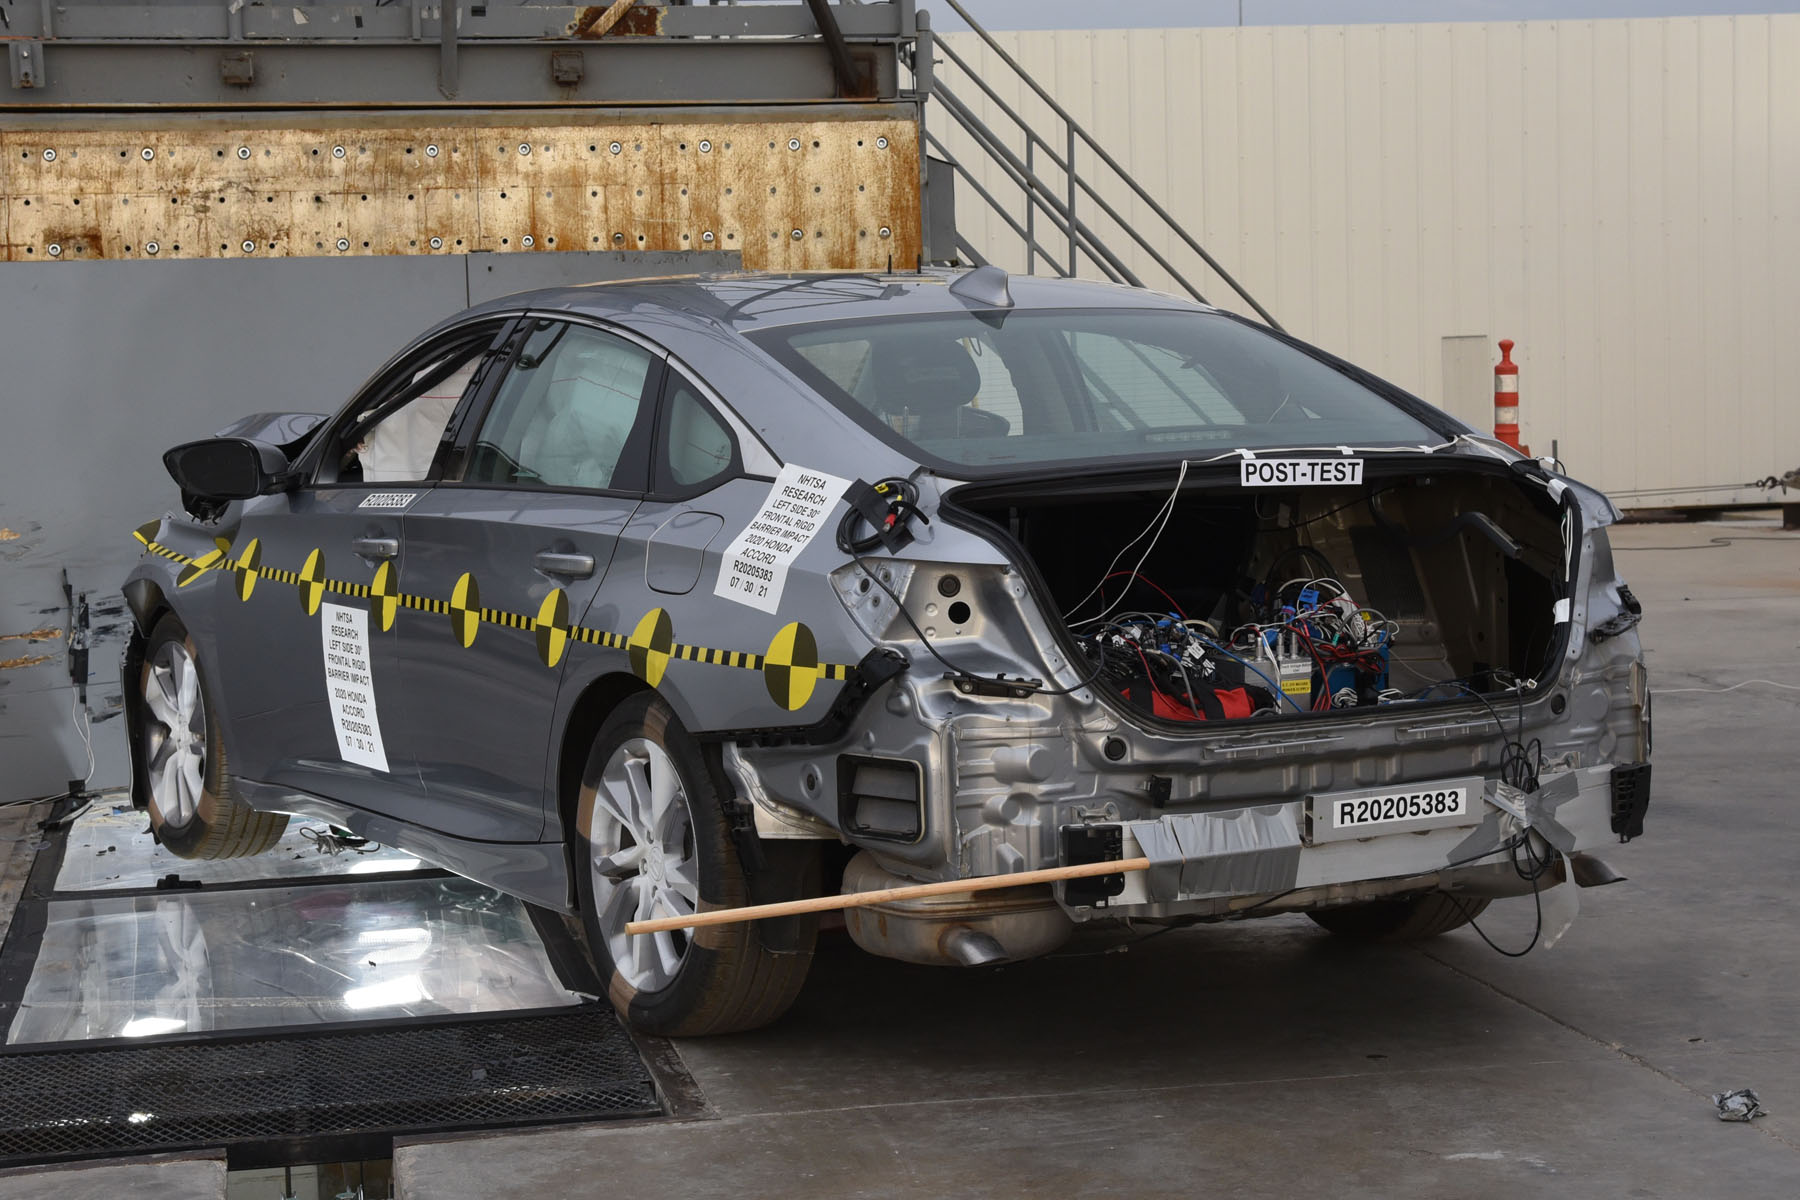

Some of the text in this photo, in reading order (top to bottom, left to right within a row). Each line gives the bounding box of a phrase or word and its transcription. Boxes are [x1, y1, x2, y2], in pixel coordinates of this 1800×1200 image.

[1245, 462, 1361, 483] POST-TEST
[797, 474, 827, 490] NHTSA
[781, 485, 828, 506] RESEARCH
[773, 499, 791, 512] LEFT
[790, 503, 809, 516] SIDE
[762, 511, 815, 531] FRONTAL RIGID
[750, 522, 810, 543] BARRIER IMPACT
[745, 534, 792, 554] 2020 HONDA
[741, 548, 776, 564] ACCORD
[734, 560, 773, 581] R20205383
[336, 611, 353, 625] NHTSA
[331, 625, 359, 640] RESEARCH
[328, 639, 341, 651] LEFT
[342, 642, 353, 654] SIDE
[328, 653, 367, 671] FRONTAL RIGID
[328, 667, 370, 687] BARRIER IMPACT
[334, 687, 368, 705] 2020 HONDA
[342, 704, 366, 719] ACCORD
[342, 719, 372, 736] R20205383
[1340, 790, 1459, 825] R20205383
